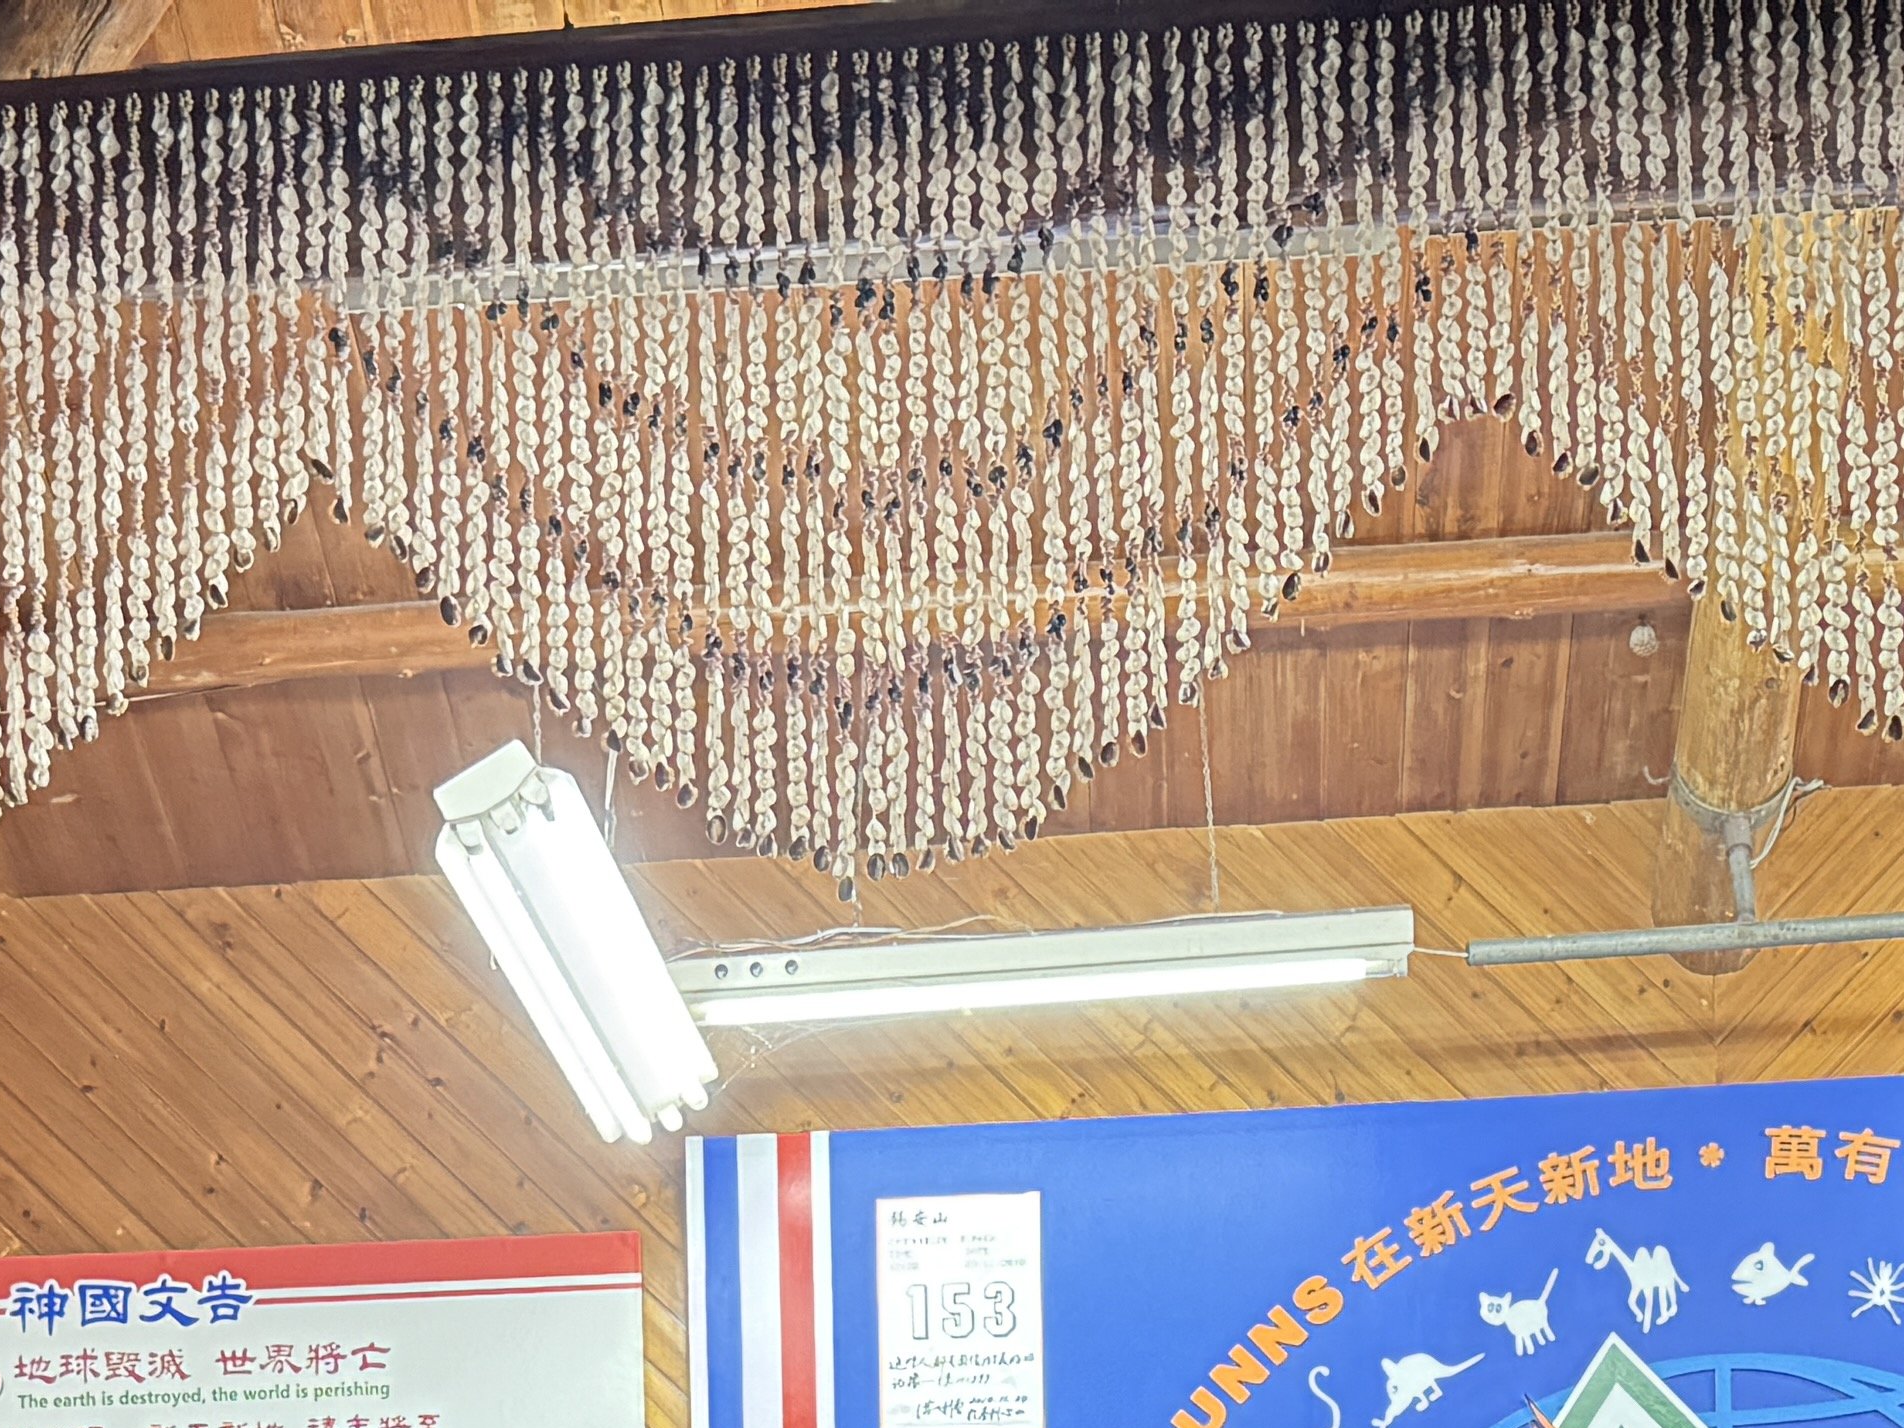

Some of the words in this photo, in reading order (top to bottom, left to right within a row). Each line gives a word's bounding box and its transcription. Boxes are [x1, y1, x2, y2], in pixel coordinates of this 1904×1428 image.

[1340, 1135, 1673, 1292] 在新天新地
[9, 1273, 253, 1337] 神國文告
[904, 1279, 1018, 1341] 153
[215, 1340, 392, 1377] 世界將亡
[18, 1393, 49, 1410] The
[53, 1390, 97, 1409] earth
[101, 1389, 114, 1407] is
[211, 1385, 238, 1403] the
[243, 1382, 290, 1401] world
[296, 1382, 308, 1400] is
[313, 1380, 391, 1402] perishing
